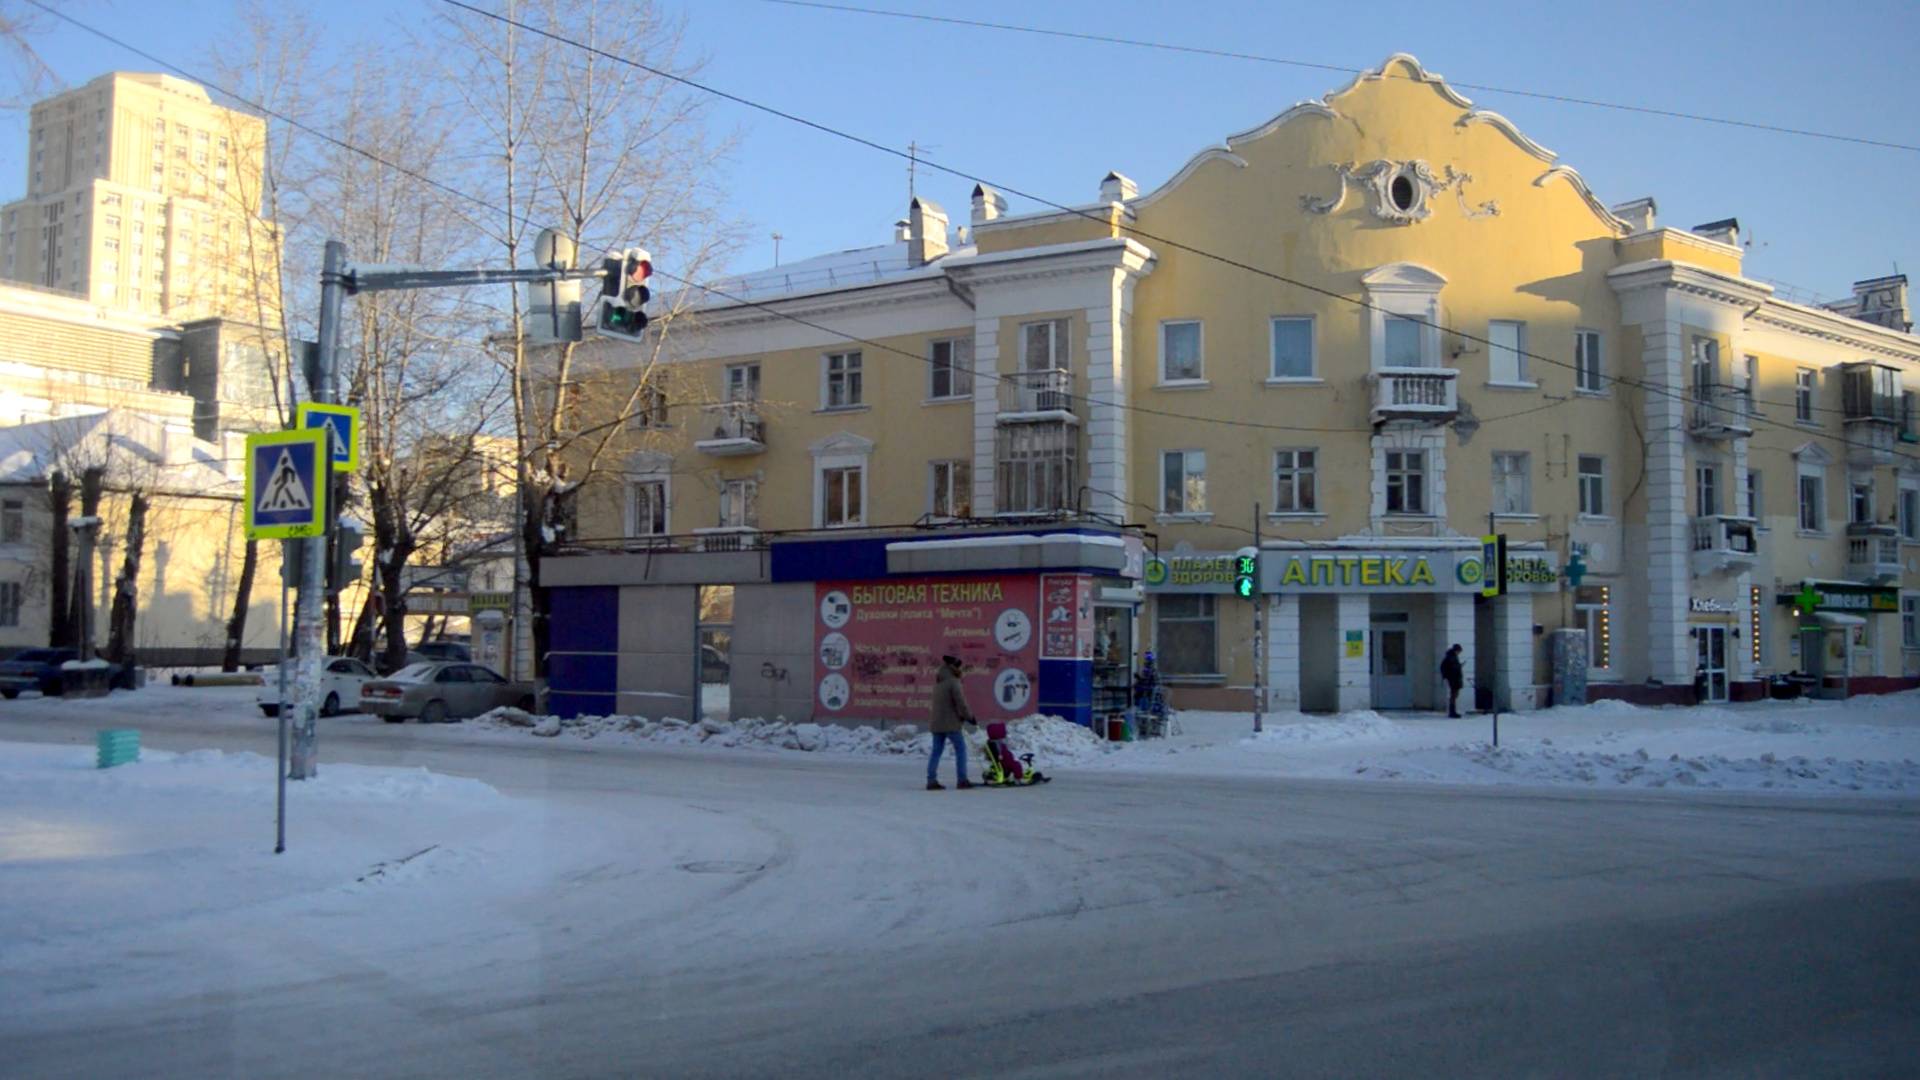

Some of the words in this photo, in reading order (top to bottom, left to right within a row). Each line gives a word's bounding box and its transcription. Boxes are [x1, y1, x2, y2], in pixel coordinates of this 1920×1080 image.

[1170, 558, 1236, 570] ПЛАНЕТ
[1505, 559, 1549, 571] АНЕТА
[1171, 571, 1235, 584] ЗДОРОВ
[1281, 557, 1436, 586] АПТЕКА
[1505, 570, 1557, 583] ОРОВЬЯ
[853, 585, 927, 604] БЫТОВАЯ
[931, 583, 1003, 603] ТЕХНИКА
